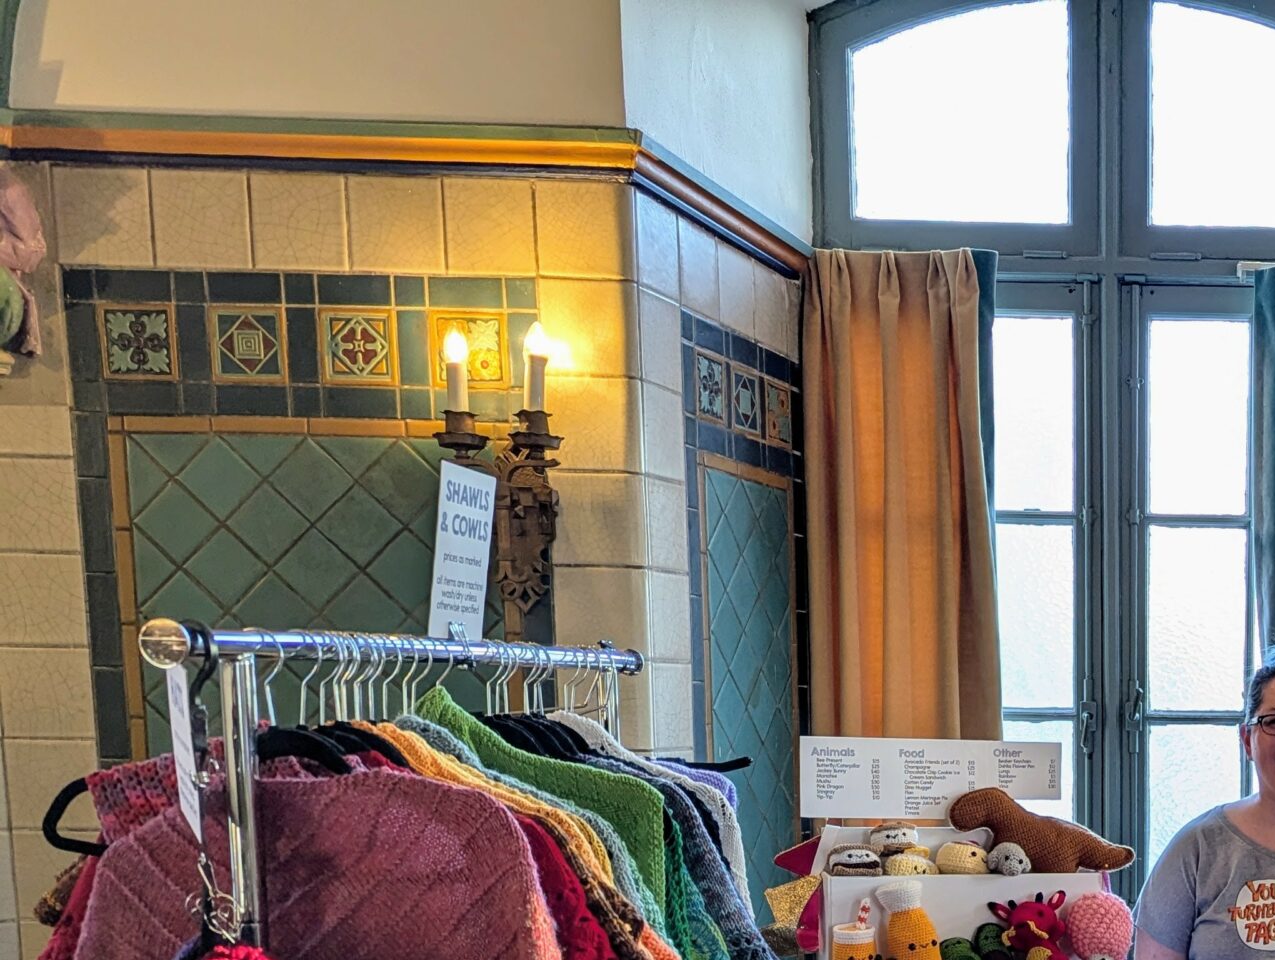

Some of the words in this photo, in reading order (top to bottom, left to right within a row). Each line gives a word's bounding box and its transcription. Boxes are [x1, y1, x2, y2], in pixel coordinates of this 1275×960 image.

[446, 479, 490, 512] SHAWLS
[440, 512, 448, 532] &
[452, 514, 488, 541] COWLS
[443, 552, 457, 564] prices
[465, 556, 481, 567] marked
[444, 578, 456, 588] items
[457, 580, 465, 588] are
[466, 580, 483, 591] machine
[442, 590, 464, 602] wash/dry
[464, 592, 477, 602] unless
[436, 600, 460, 612] otherwise
[460, 603, 479, 615] specified
[811, 747, 855, 757] Animals
[899, 749, 925, 758] Food
[993, 749, 1023, 758] Other
